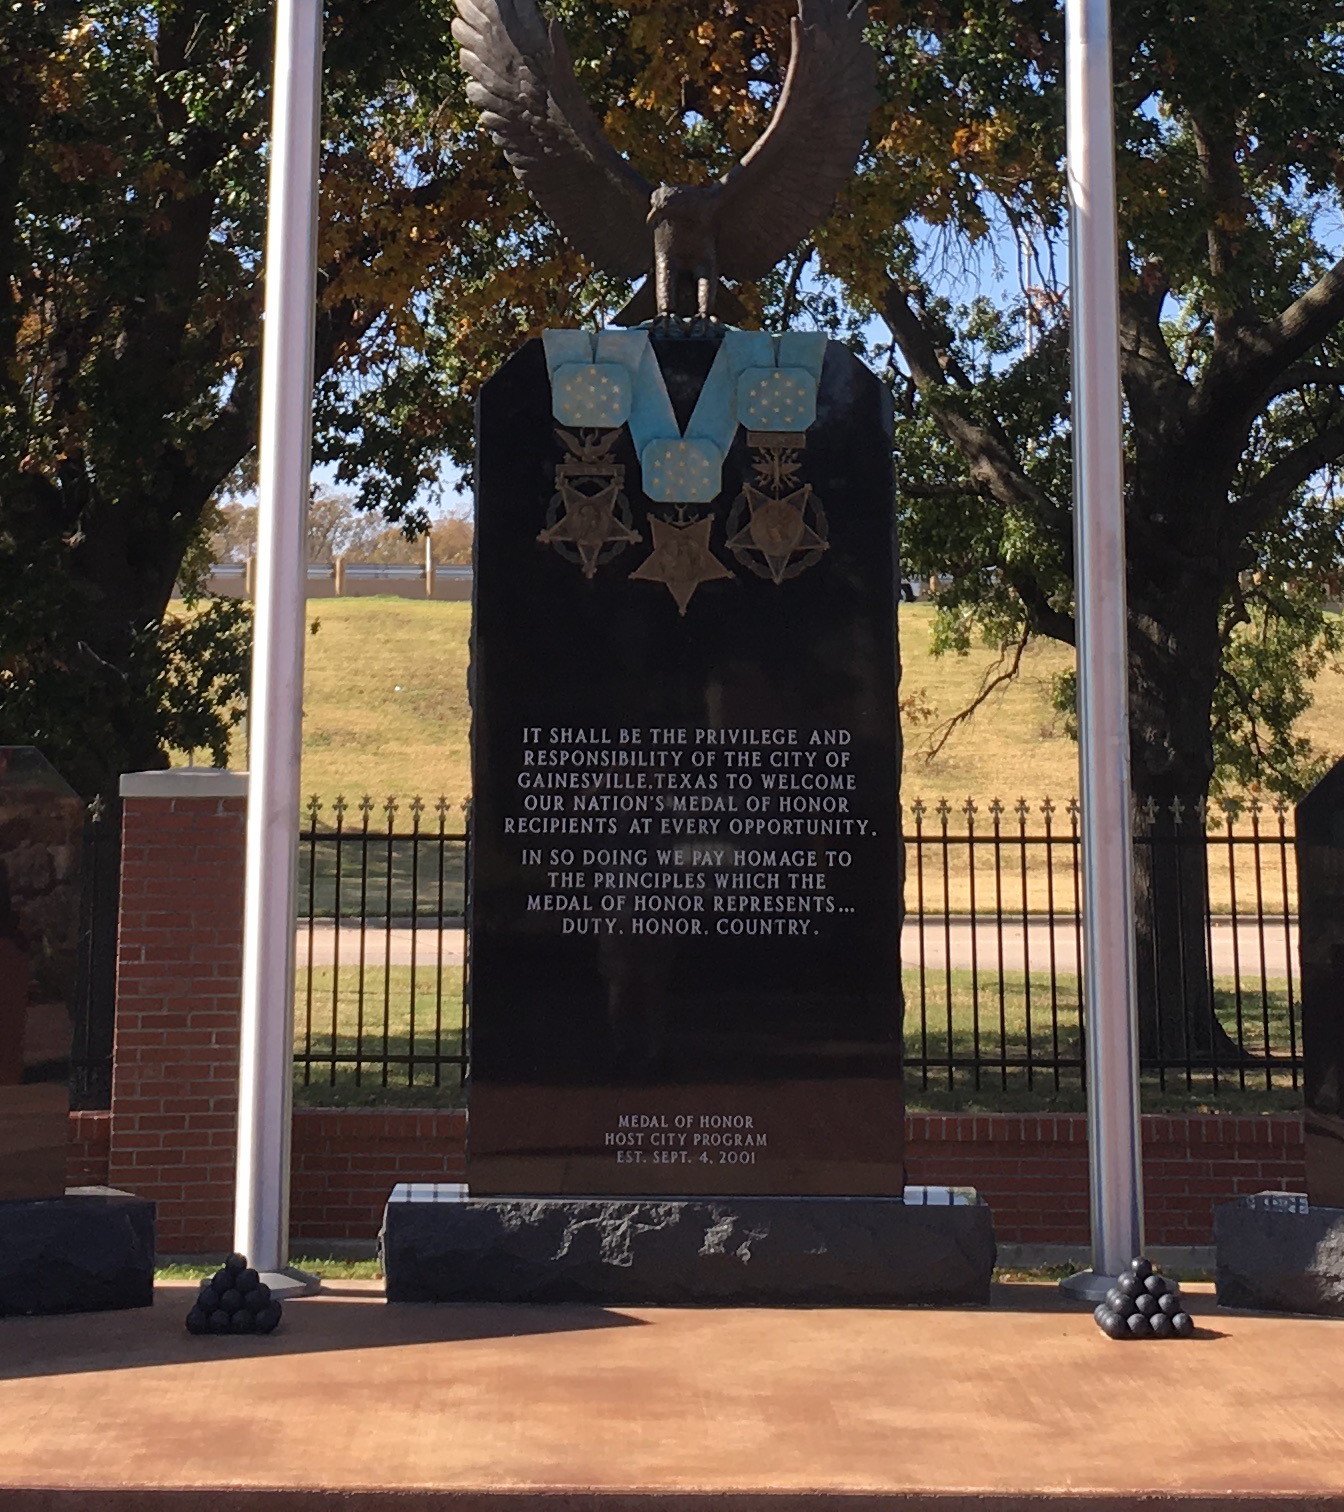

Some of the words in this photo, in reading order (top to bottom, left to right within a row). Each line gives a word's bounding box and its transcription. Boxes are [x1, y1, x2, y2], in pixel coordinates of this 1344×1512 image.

[522, 728, 541, 744] IT
[550, 728, 611, 744] SHALL
[619, 729, 642, 744] BE
[650, 729, 687, 744] THE
[695, 729, 798, 745] PRIVILEGE
[809, 730, 851, 745] AND
[523, 750, 683, 766] RESPONSIBILITY
[692, 751, 716, 766] OF
[724, 751, 761, 767] THE
[770, 751, 817, 767] CITY
[826, 752, 851, 767] OF
[654, 774, 718, 789] TEXAS
[726, 774, 752, 789] TO
[761, 774, 857, 790] WELCOME
[524, 795, 565, 811] OUR
[573, 796, 664, 811] NATION'S
[673, 796, 738, 812] MEDAL
[746, 796, 771, 812] OF
[780, 797, 850, 813] HONOR
[504, 818, 618, 834] RECIPIENTS
[629, 818, 653, 834] AT
[661, 818, 720, 834] EVERY
[729, 819, 878, 836] OPPORTUNITY.
[522, 849, 542, 865] IN
[550, 849, 575, 865] SO
[583, 850, 648, 866] DOING
[656, 850, 684, 866] WE
[692, 850, 725, 866] PAY
[733, 850, 818, 866] HOMAGE
[826, 851, 852, 866] TO
[548, 872, 586, 888] THE
[594, 873, 706, 888] PRINCIPLES
[714, 873, 780, 889] WHICH
[788, 873, 826, 889] THE
[527, 895, 593, 911] MEDAL
[601, 895, 626, 911] OF
[634, 896, 704, 911] HONOR
[717, 919, 819, 936] COUNTRY.
[618, 1115, 669, 1128] MEDAL
[675, 1115, 694, 1128] OF
[700, 1115, 754, 1128] HONOR
[605, 1133, 644, 1145] HOST
[651, 1133, 687, 1145] CITY
[693, 1134, 768, 1146] PROGRAM
[617, 1151, 647, 1163] EST.
[653, 1151, 692, 1164] SEPT.
[719, 1152, 756, 1164] 2001
